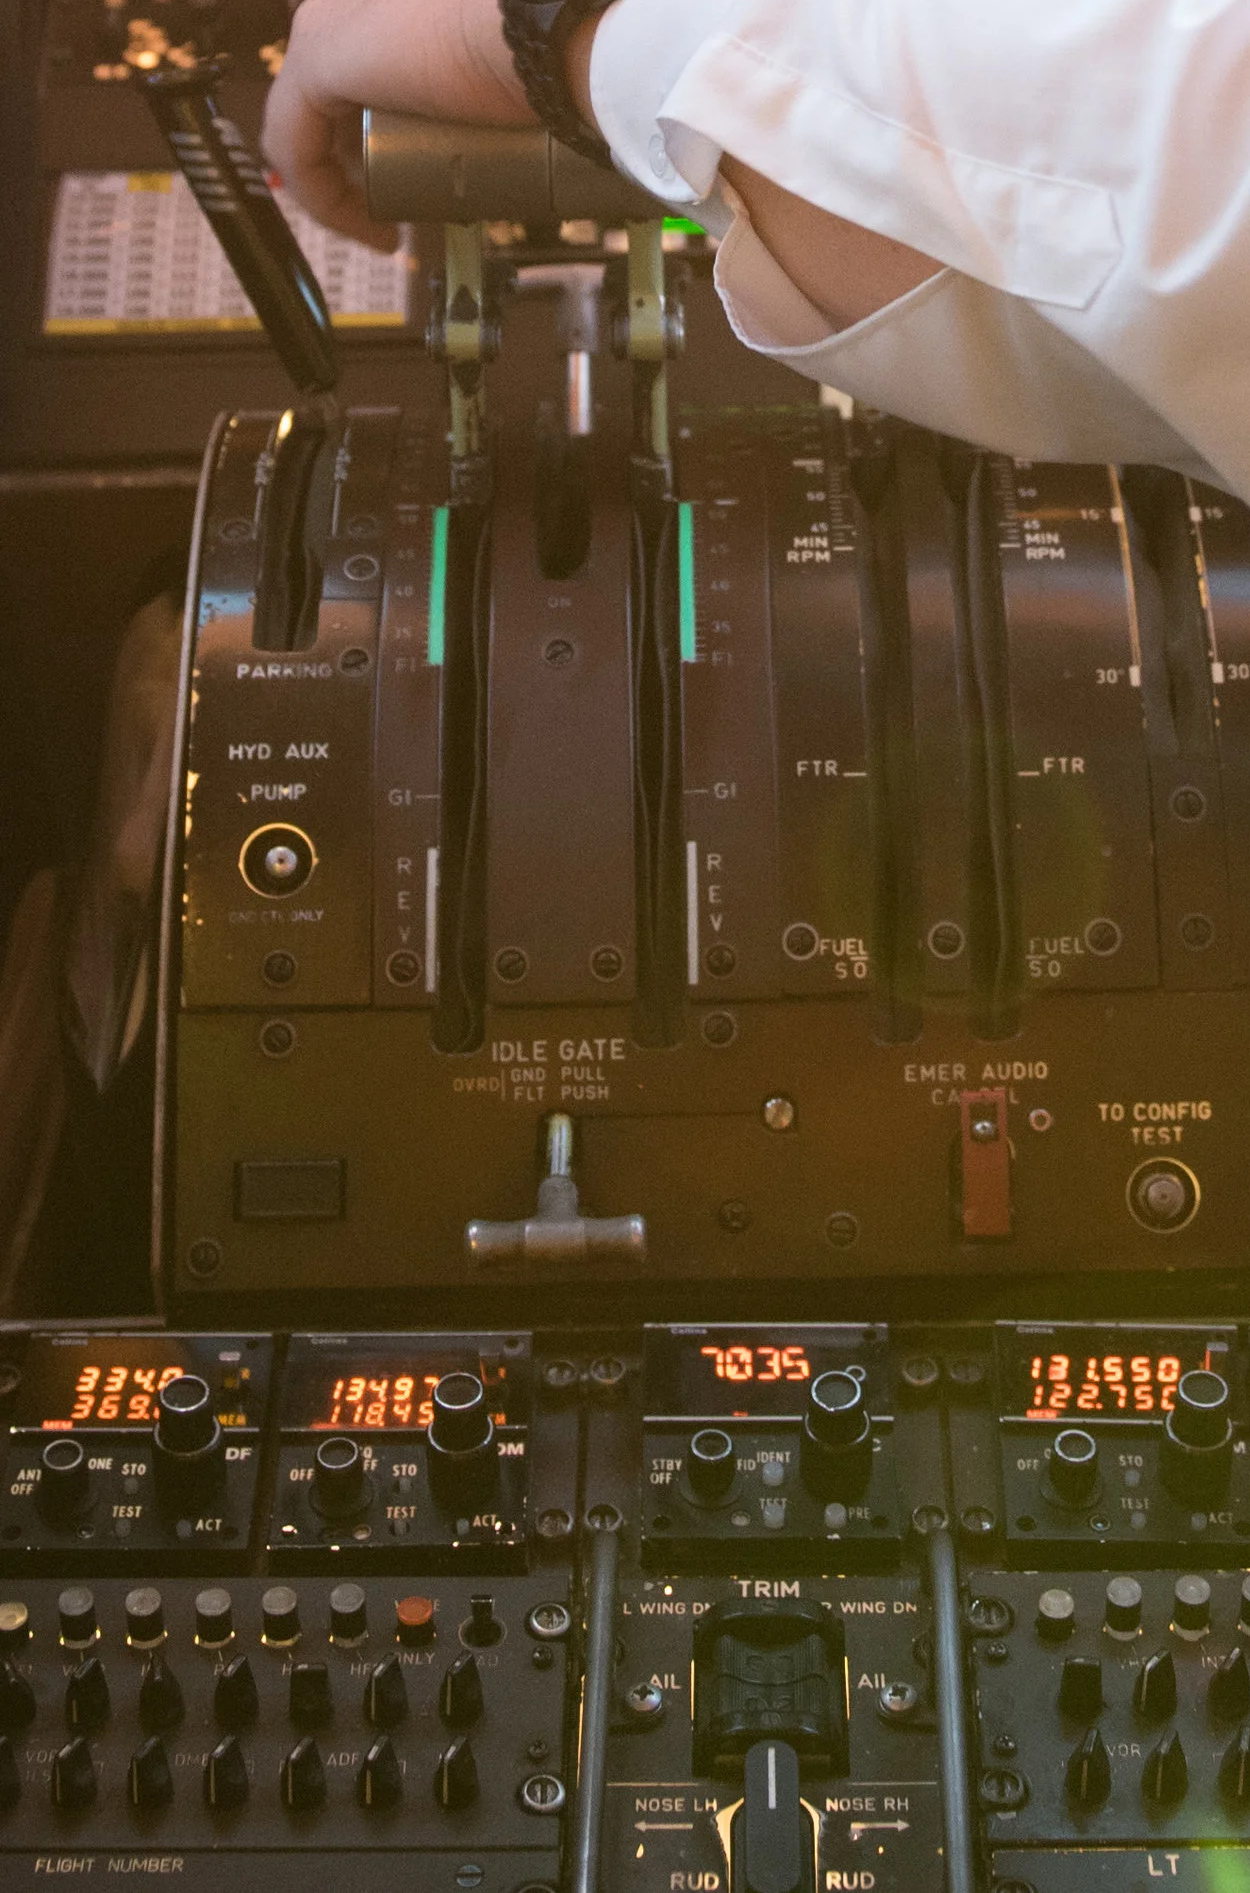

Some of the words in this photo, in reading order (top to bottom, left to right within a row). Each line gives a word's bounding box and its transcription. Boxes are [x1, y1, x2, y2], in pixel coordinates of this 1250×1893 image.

[793, 536, 829, 548] MIN
[1024, 533, 1059, 545] MIN
[786, 551, 830, 563] RPM
[1026, 547, 1065, 560] RPM
[236, 663, 333, 679] PARKING
[229, 743, 272, 760] HYD
[285, 743, 329, 759] AUX
[796, 760, 838, 776] FTR
[1043, 758, 1085, 774] FTR
[251, 784, 307, 801] PUMP
[388, 788, 412, 805] GI
[714, 782, 736, 799] GI
[819, 938, 867, 956] FUEL
[1028, 937, 1085, 955] FUEL
[491, 1040, 548, 1062] IDLE
[559, 1038, 626, 1061] GATE
[510, 1068, 546, 1083] GND
[561, 1066, 606, 1082] PULL
[904, 1063, 967, 1082] EMER
[982, 1061, 1049, 1080] AUDIO
[453, 1077, 500, 1092] OVRD
[513, 1086, 544, 1101] FLT
[561, 1085, 610, 1100] PUSH
[931, 1088, 1020, 1105] CAL
[1098, 1103, 1124, 1121] TO
[1133, 1102, 1213, 1121] CONFIG
[1131, 1126, 1184, 1145] TEST
[701, 1346, 811, 1381] 7035
[1030, 1354, 1180, 1383] 131.550
[70, 1393, 160, 1420] 369.
[225, 1447, 253, 1460] DF
[757, 1451, 791, 1464] IDENT
[88, 1457, 113, 1470] ONE
[652, 1459, 682, 1471] STBY
[1016, 1459, 1039, 1471] OFF
[1119, 1455, 1143, 1468] STO
[122, 1463, 146, 1476] STO
[289, 1468, 314, 1481] OFF
[392, 1464, 417, 1477] STO
[650, 1472, 672, 1484] OFF
[11, 1484, 34, 1496] OFF
[1121, 1497, 1149, 1509] TEST
[112, 1506, 143, 1518] TEST
[386, 1506, 416, 1519] TEST
[848, 1507, 871, 1519] PRE
[1209, 1512, 1234, 1524] ACT
[195, 1518, 223, 1531] ACT
[473, 1514, 497, 1527] ACT
[738, 1580, 801, 1598] TRIM
[623, 1602, 632, 1615] L
[639, 1602, 686, 1615] WING
[840, 1601, 886, 1614] WING
[893, 1601, 918, 1614] DN
[650, 1673, 682, 1690] AIL
[1106, 1743, 1141, 1757] VOR
[326, 1752, 358, 1767] ADF
[636, 1797, 686, 1812] NOSE
[693, 1797, 718, 1812] LH
[825, 1797, 876, 1812] NOSE
[884, 1797, 909, 1812] RH
[34, 1857, 96, 1874] FLIGHT
[107, 1857, 185, 1874] NUMBER
[1148, 1854, 1180, 1877] LT
[670, 1870, 720, 1891] RUD
[825, 1870, 876, 1891] RUD
